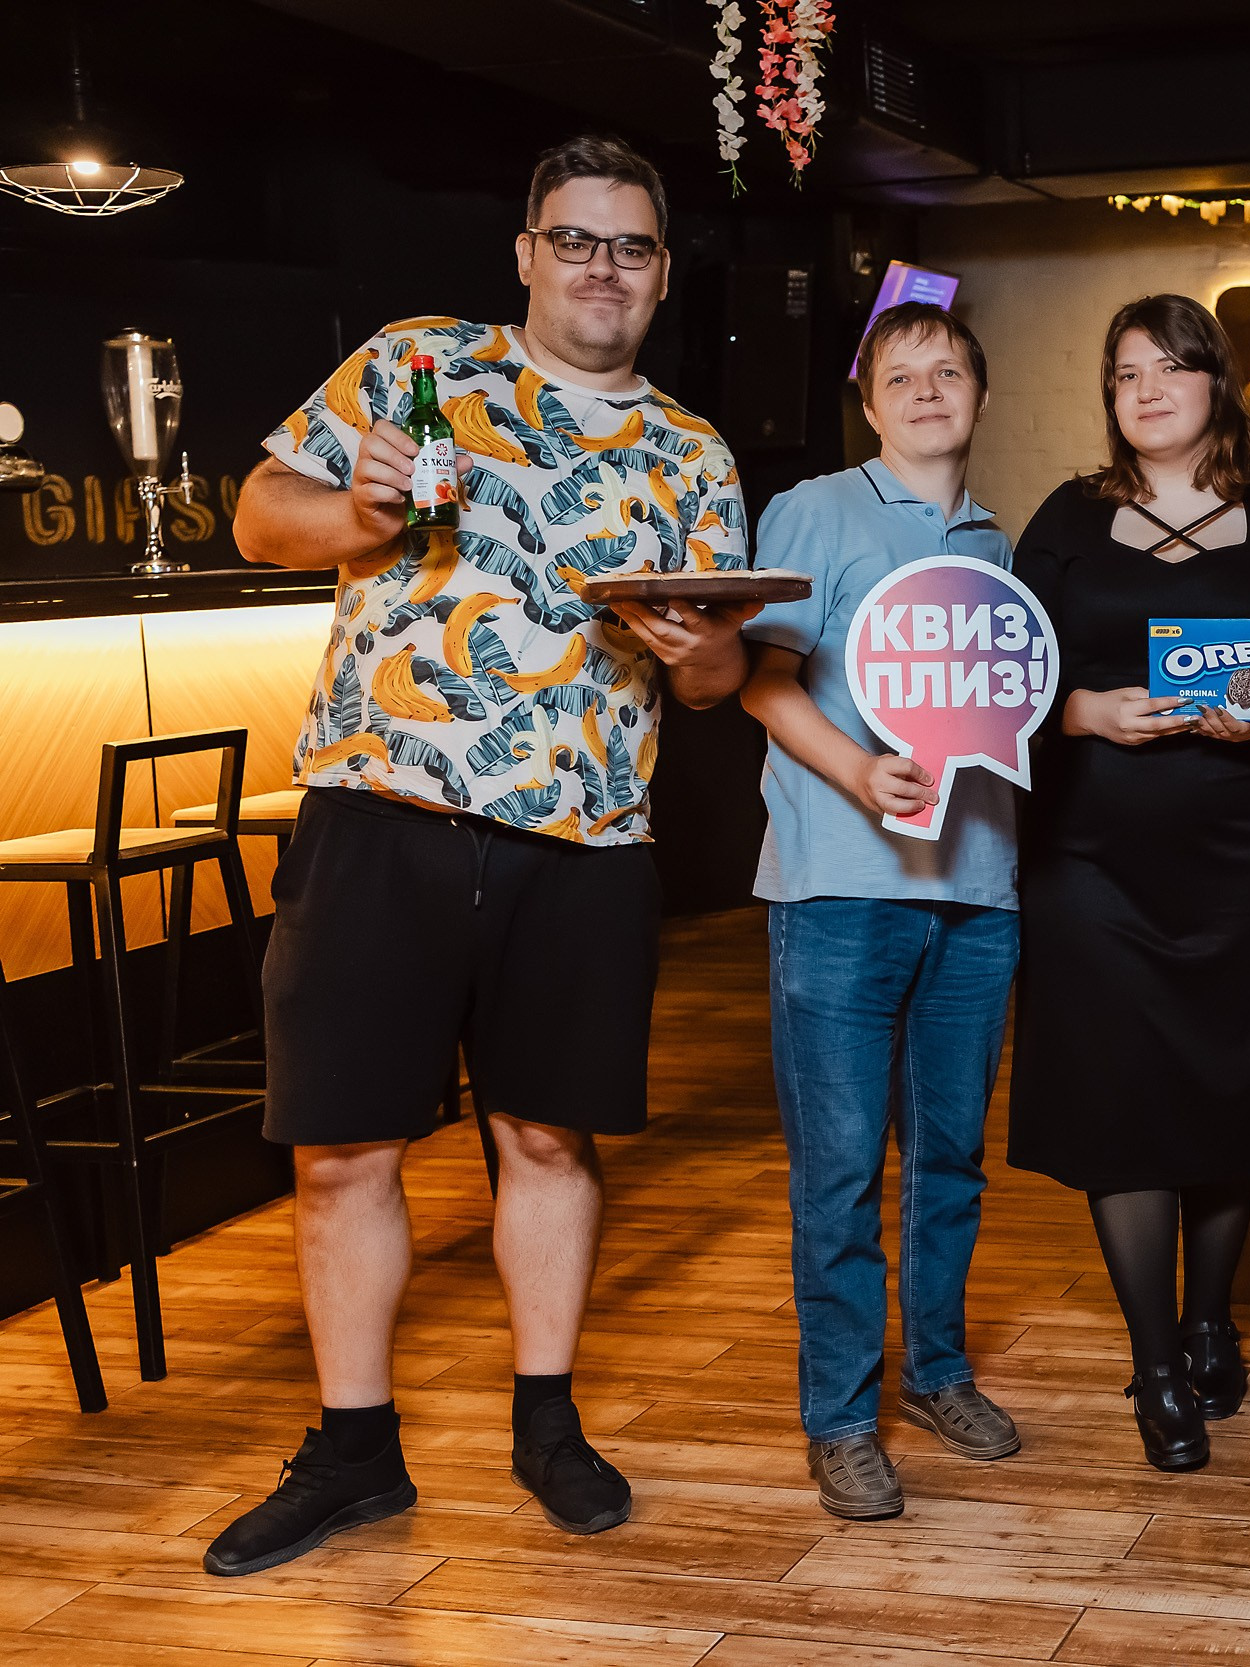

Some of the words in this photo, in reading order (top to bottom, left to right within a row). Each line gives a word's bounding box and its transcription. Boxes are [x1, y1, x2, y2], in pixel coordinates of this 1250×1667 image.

[869, 602, 1047, 660] КВИЗ,
[864, 659, 1046, 709] ПЛИЗ!
[1179, 689, 1218, 698] ORIGINAL
